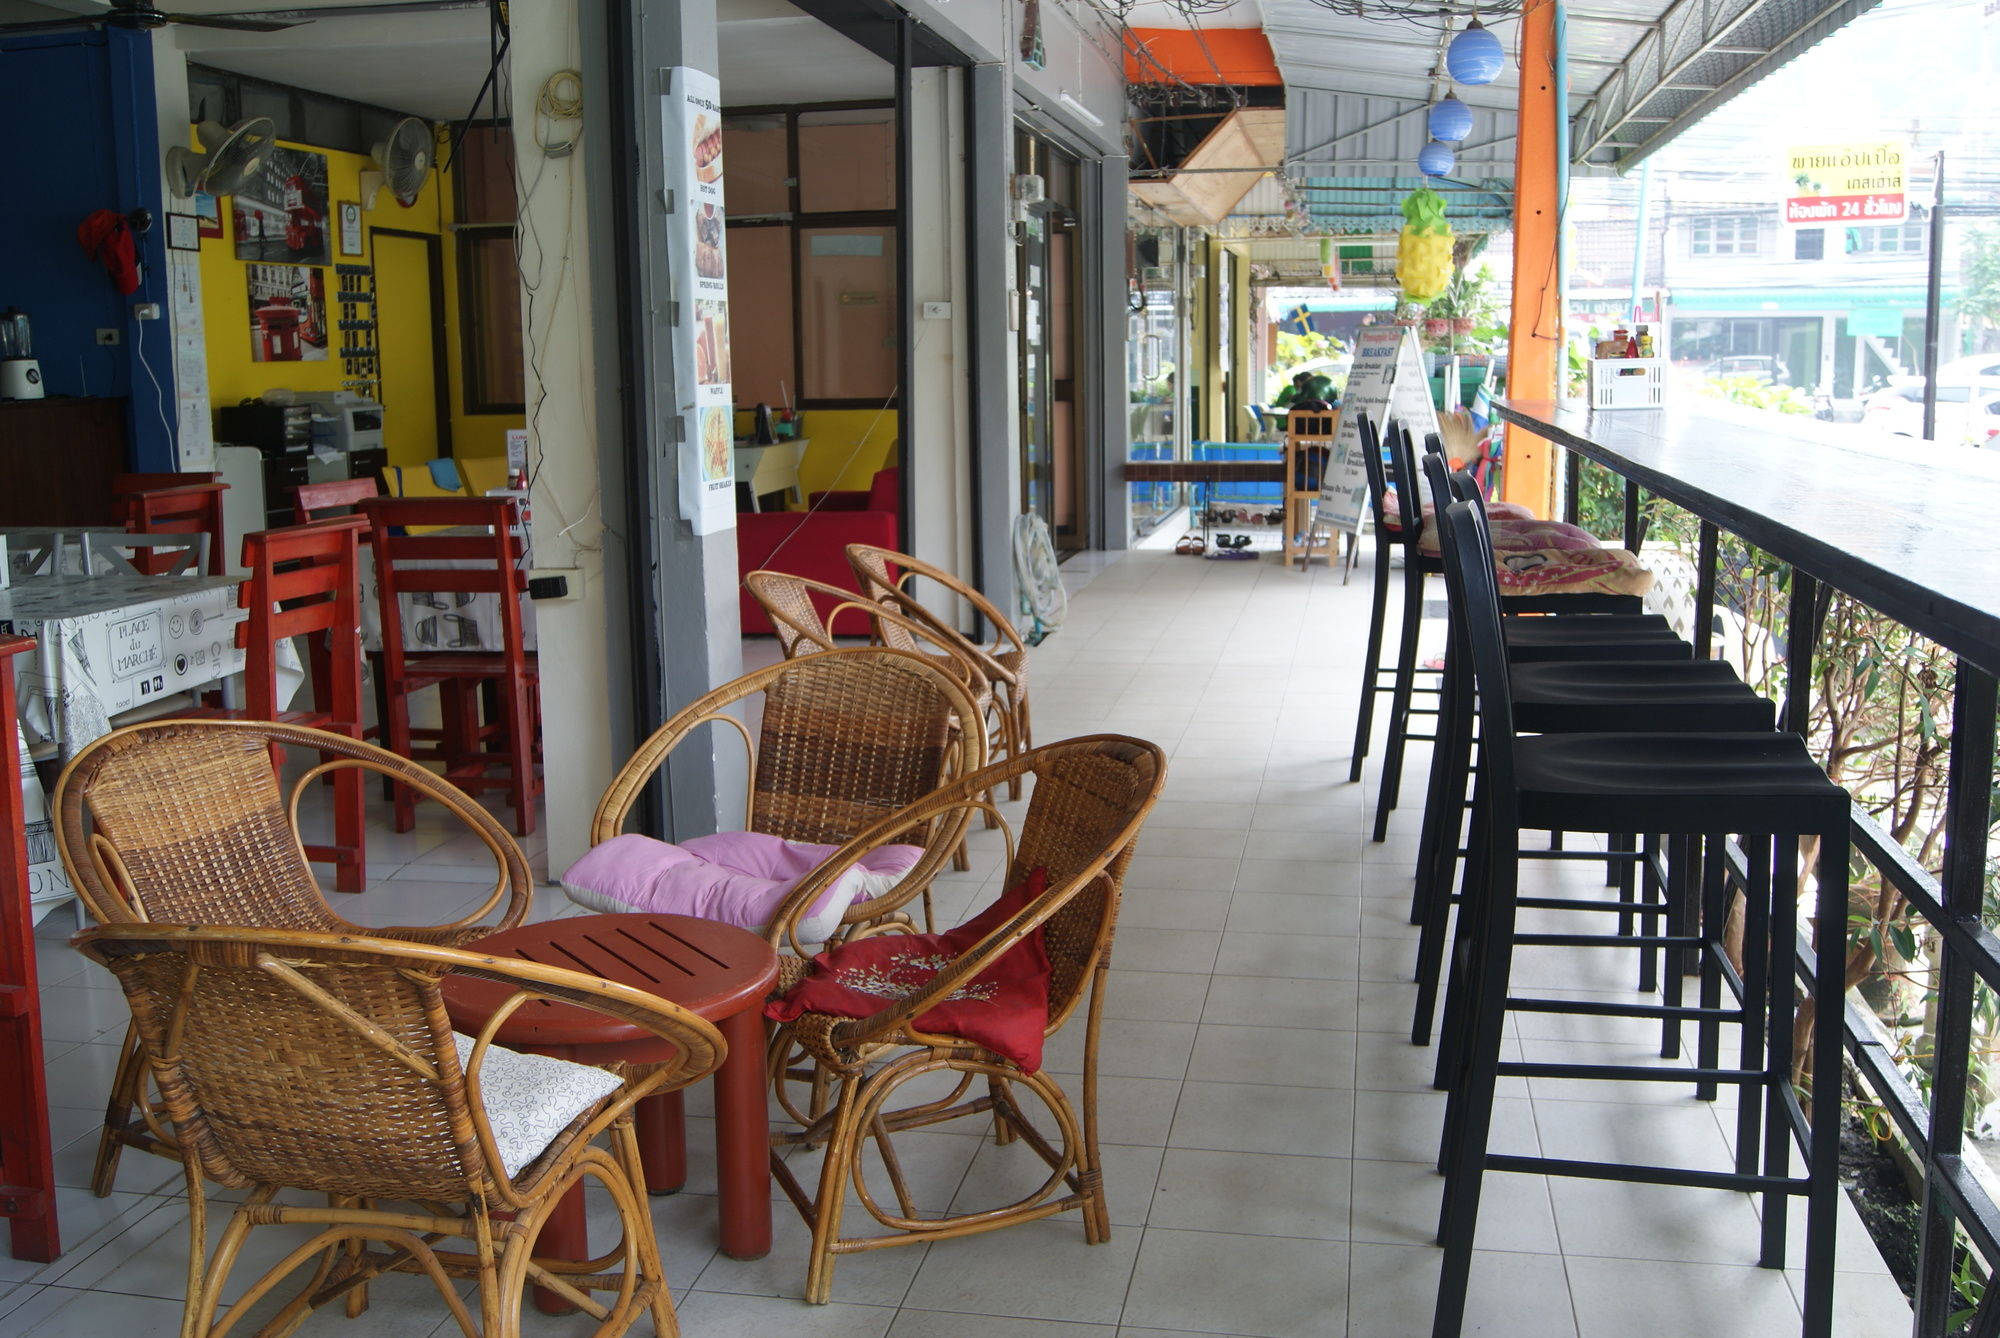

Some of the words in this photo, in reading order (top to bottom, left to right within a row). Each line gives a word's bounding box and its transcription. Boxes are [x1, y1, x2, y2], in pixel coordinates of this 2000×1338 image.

[686, 94, 695, 104] ALL
[704, 99, 712, 110] 50
[1788, 201, 1837, 219] ห้องพัก
[1841, 201, 1860, 217] 24
[1863, 195, 1903, 216] ชั่วโมง
[1362, 347, 1395, 357] BREAKFAST
[118, 617, 150, 639] PLACE
[129, 638, 141, 651] du
[117, 643, 158, 672] MARCHÉ
